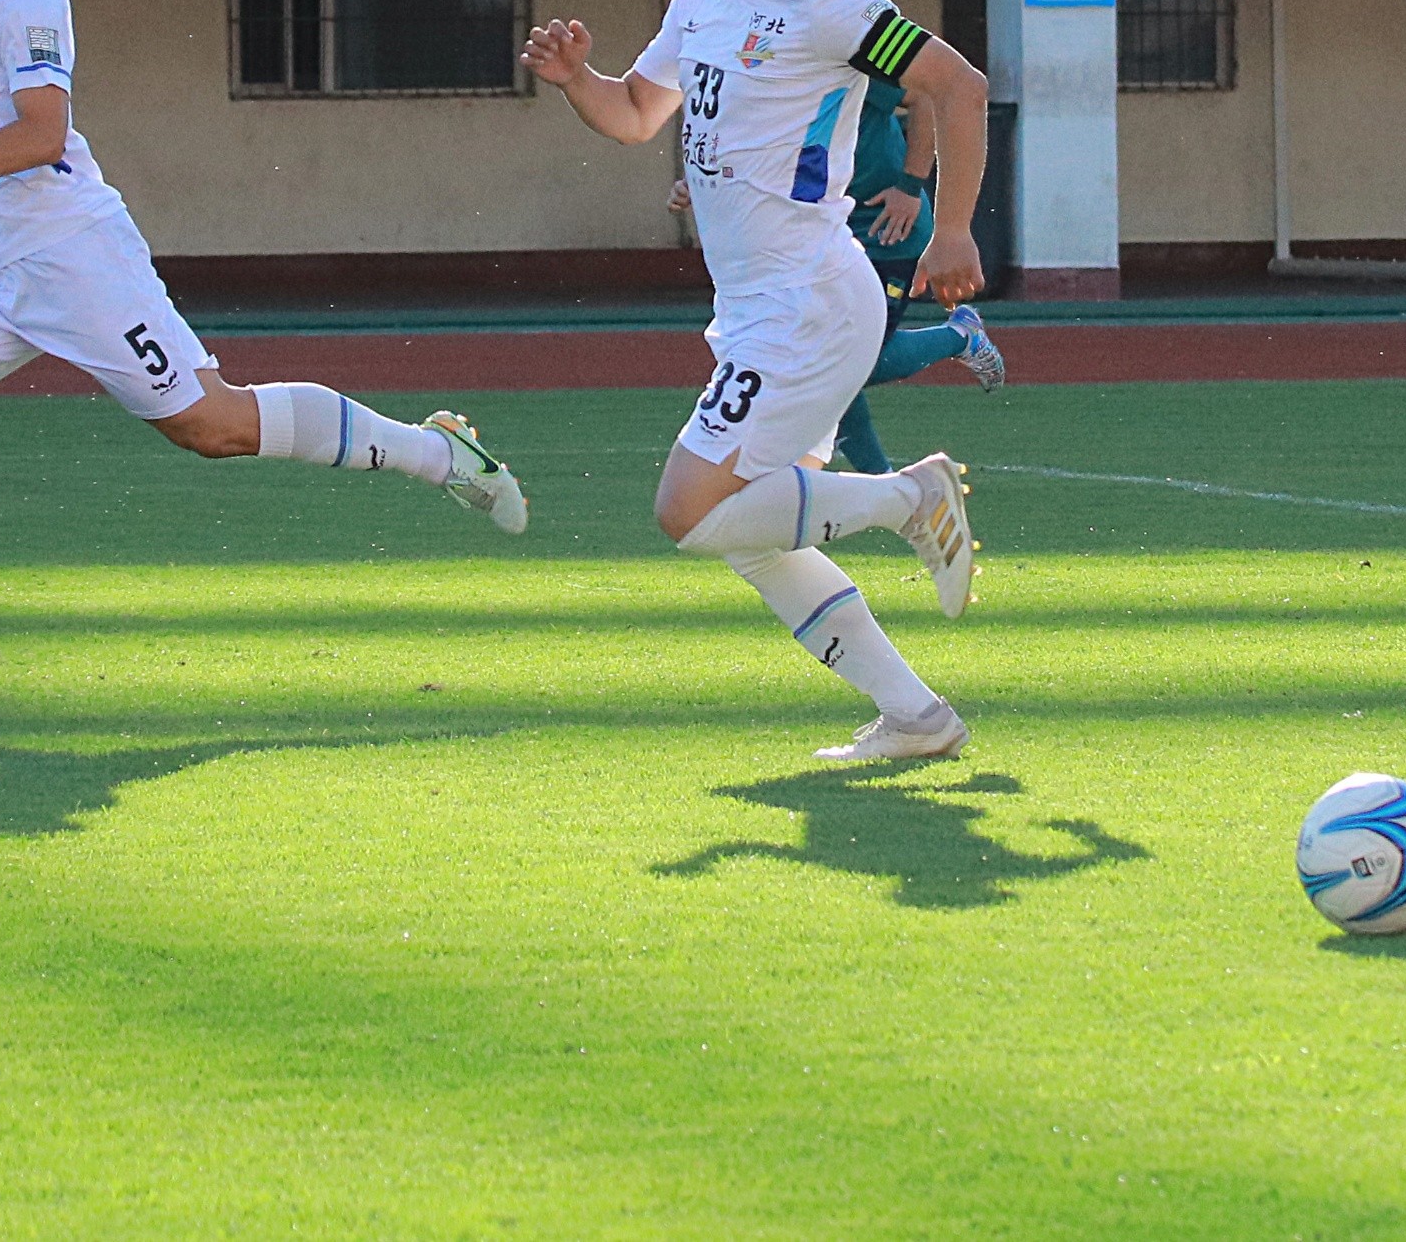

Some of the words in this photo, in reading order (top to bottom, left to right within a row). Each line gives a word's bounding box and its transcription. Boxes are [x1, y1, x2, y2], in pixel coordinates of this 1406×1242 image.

[749, 11, 786, 35] 河北
[690, 62, 724, 120] 33
[124, 323, 168, 376] 5
[700, 362, 762, 423] 33
